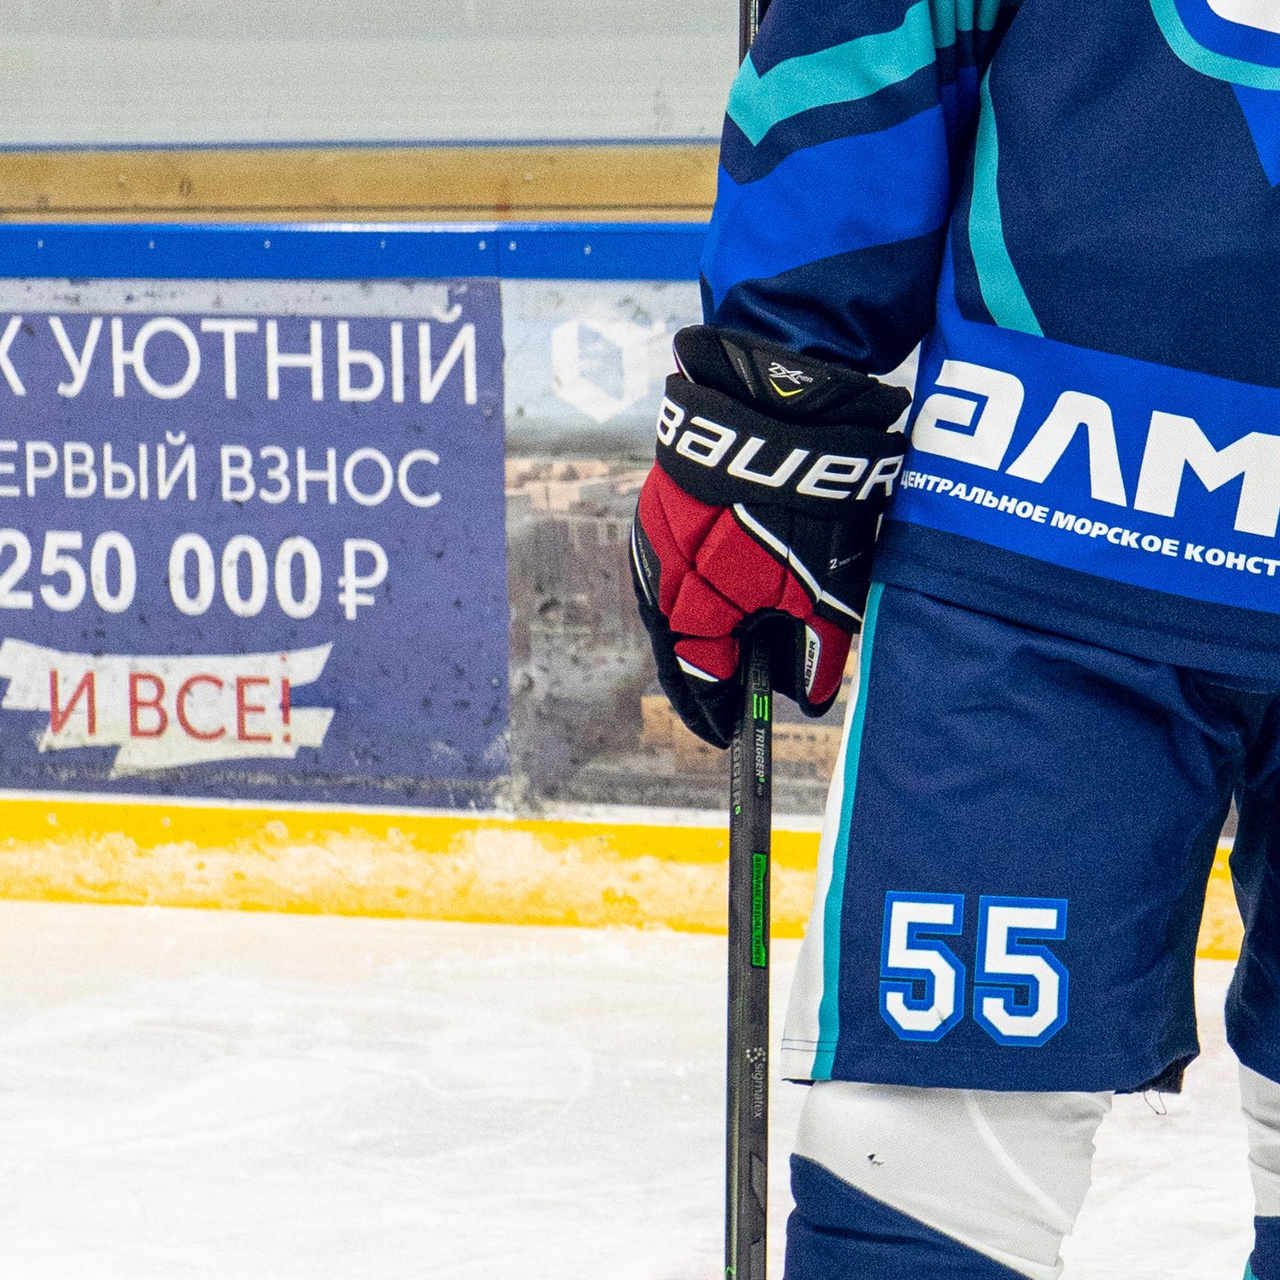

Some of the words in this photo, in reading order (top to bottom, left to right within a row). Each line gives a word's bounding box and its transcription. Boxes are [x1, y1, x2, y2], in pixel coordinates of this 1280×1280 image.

[48, 304, 478, 405] УЮТНЫЙ
[221, 444, 442, 507] ВЗНОС
[900, 469, 1050, 524] ЦЕНТРАЛЬНОЕ
[1051, 510, 1179, 558] МОРСКОЕ
[0, 527, 137, 613] 250
[49, 669, 97, 737] И
[128, 671, 293, 744] ВСЕ!
[882, 895, 1065, 1043] 55
